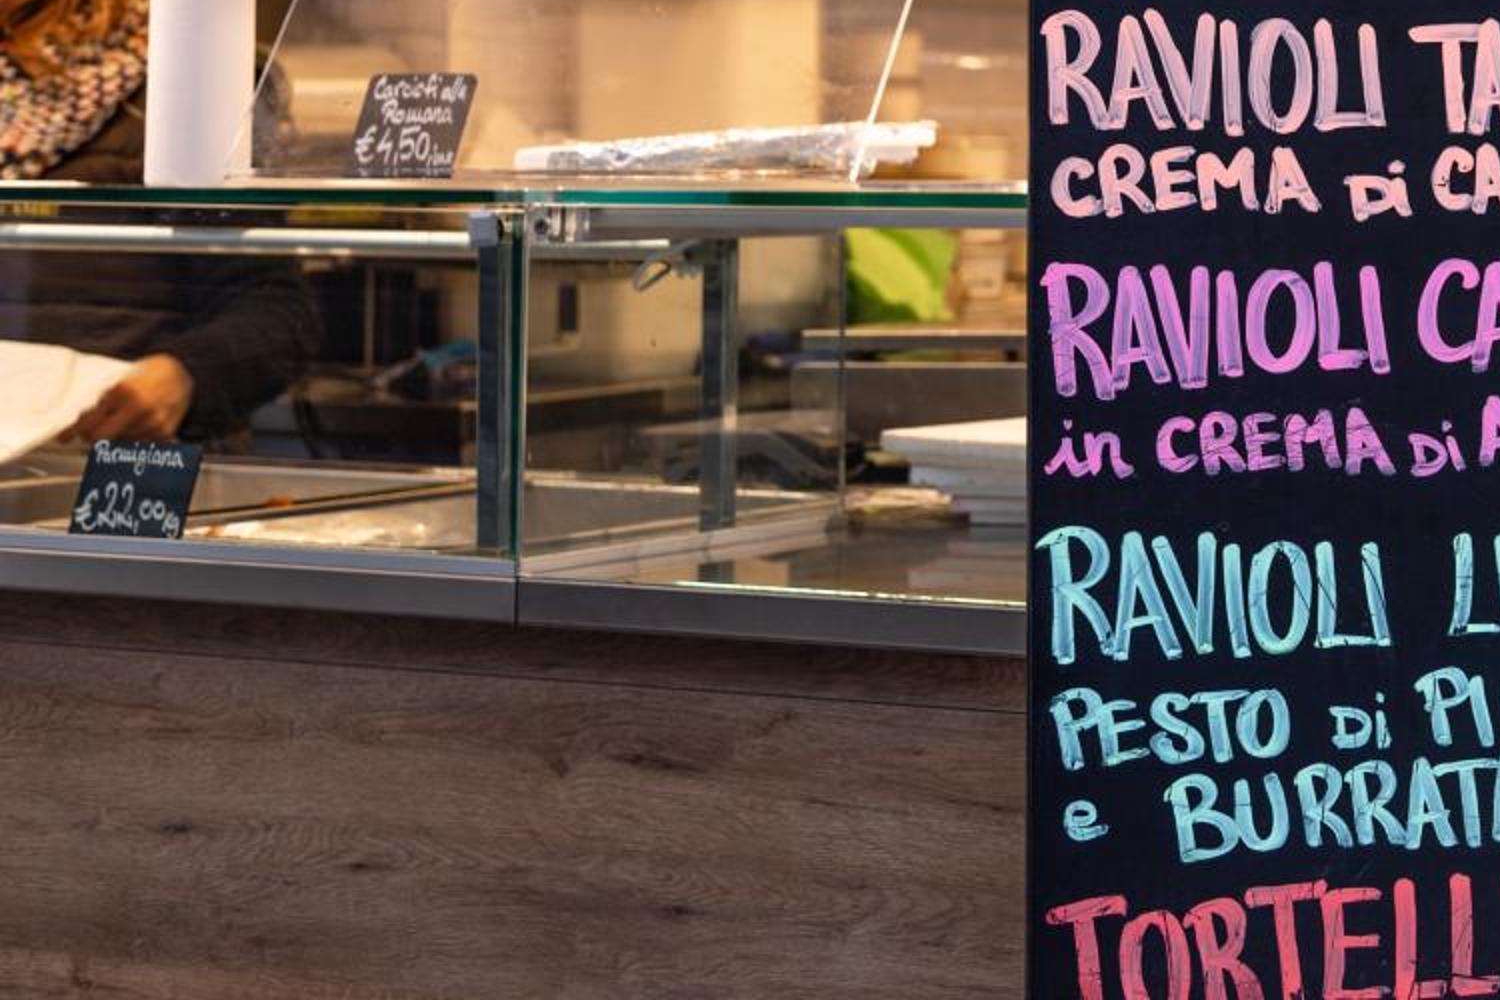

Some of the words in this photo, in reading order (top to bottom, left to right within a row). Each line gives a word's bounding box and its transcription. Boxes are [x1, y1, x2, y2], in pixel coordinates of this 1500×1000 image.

[1041, 8, 1387, 137] RAVIOLI
[381, 98, 453, 126] Romana
[1050, 143, 1320, 220] CREMA
[1041, 257, 1390, 400] RAVIOLI
[94, 439, 184, 477] Parmigiana
[1043, 421, 1135, 479] in
[1156, 406, 1396, 476] CREMA
[1036, 525, 1392, 663] RAVIOLI
[1050, 685, 1291, 771] PESTO
[1063, 797, 1109, 841] e
